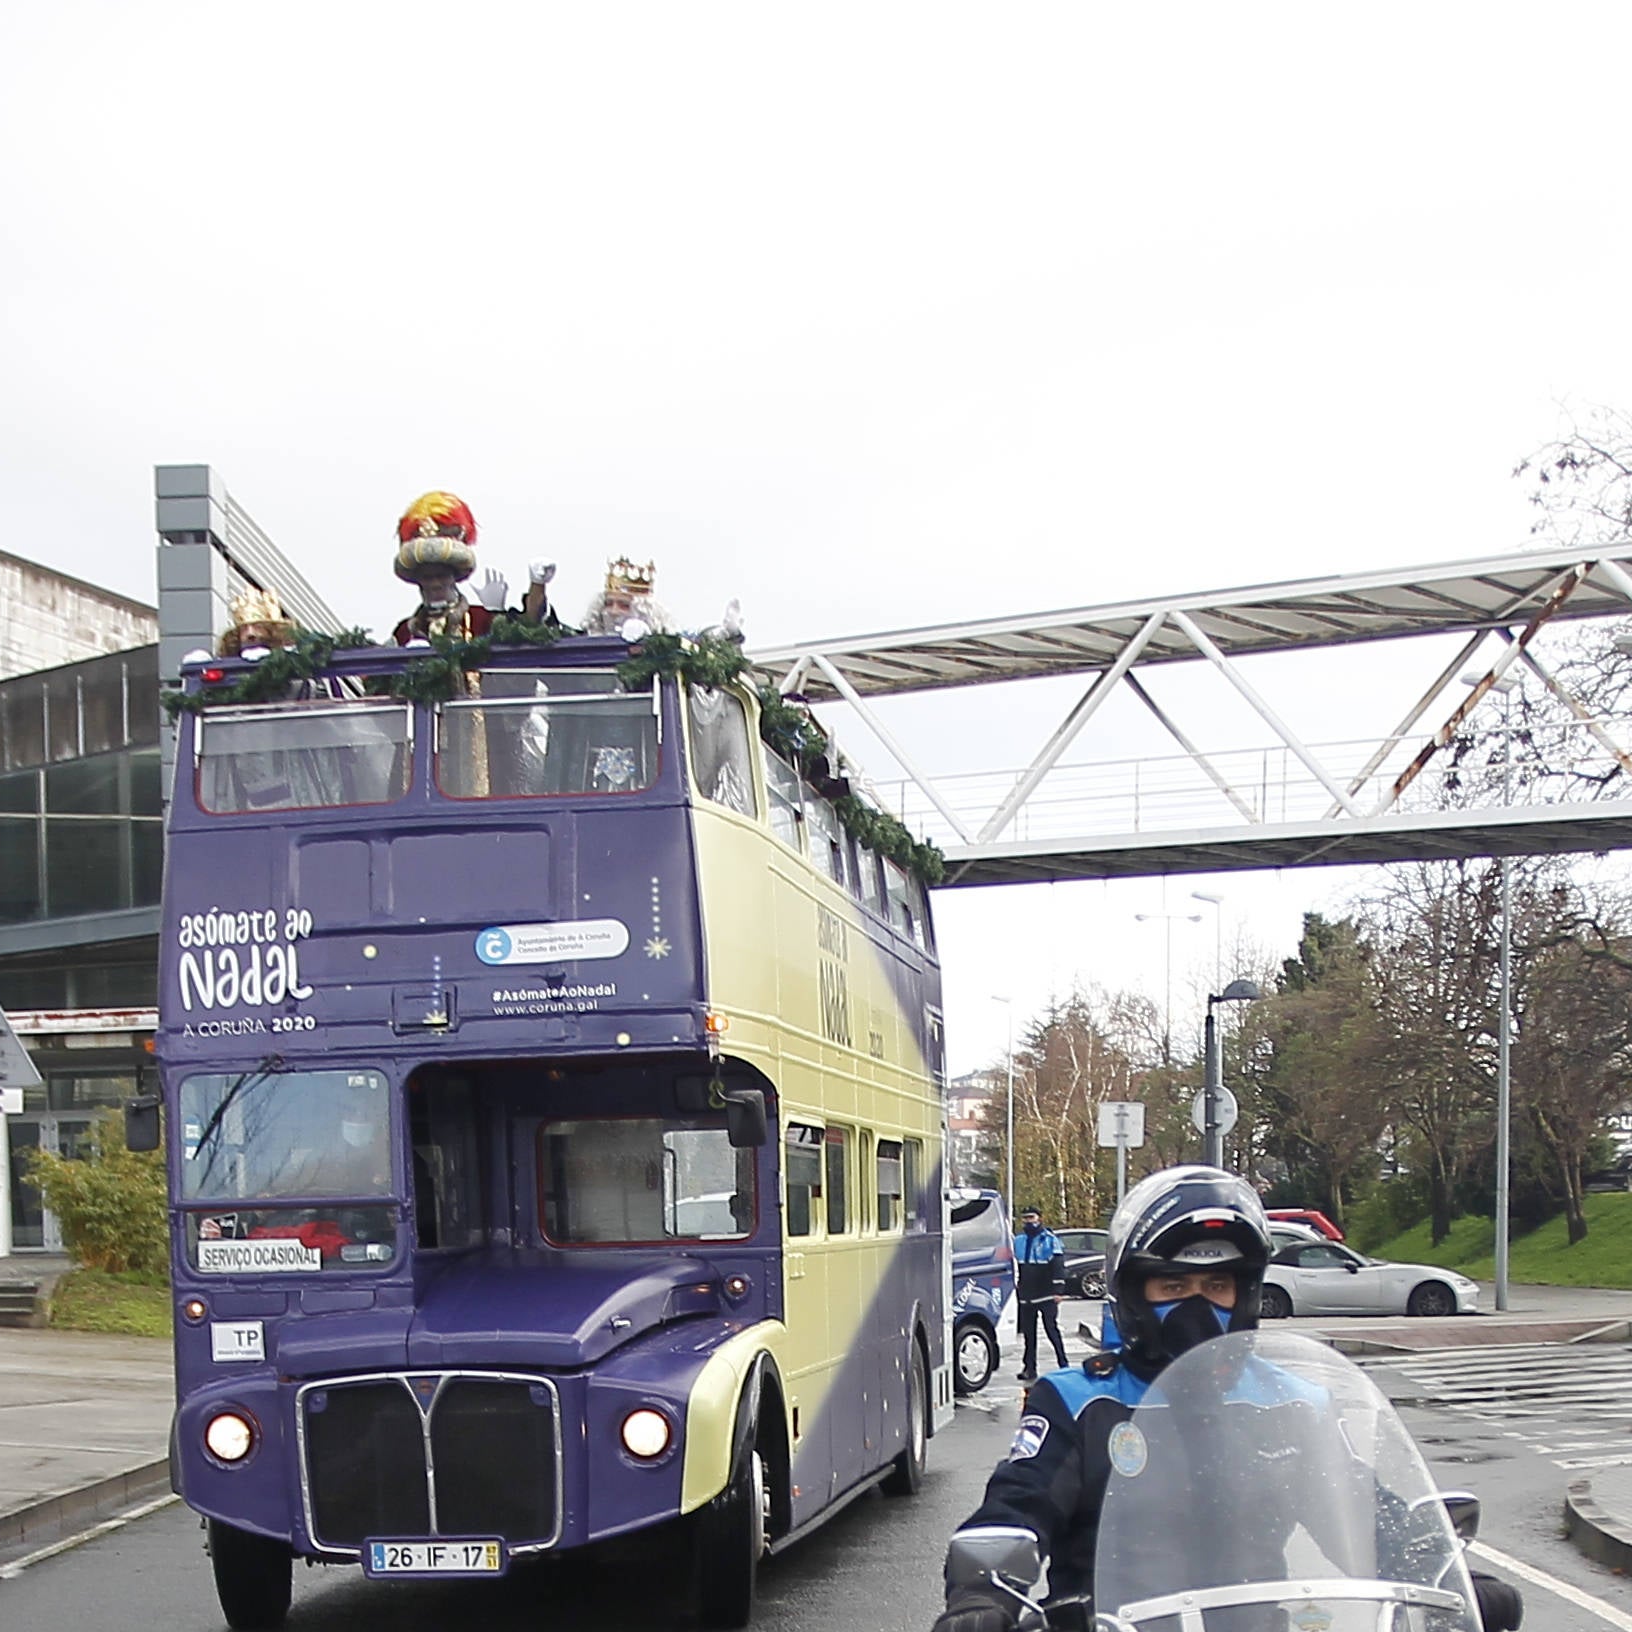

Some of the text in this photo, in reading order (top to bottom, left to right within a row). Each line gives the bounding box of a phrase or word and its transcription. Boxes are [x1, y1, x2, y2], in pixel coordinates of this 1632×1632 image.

[179, 906, 313, 948] asómate ao
[179, 944, 314, 1011] Nadal
[492, 983, 616, 1003] #AsómateAoNadal
[494, 1000, 598, 1016] www.coruna.gal
[183, 1015, 316, 1038] A CORUÑA 2020
[204, 1246, 318, 1271] SERVIÇO OCASIONAL
[233, 1329, 259, 1347] TP
